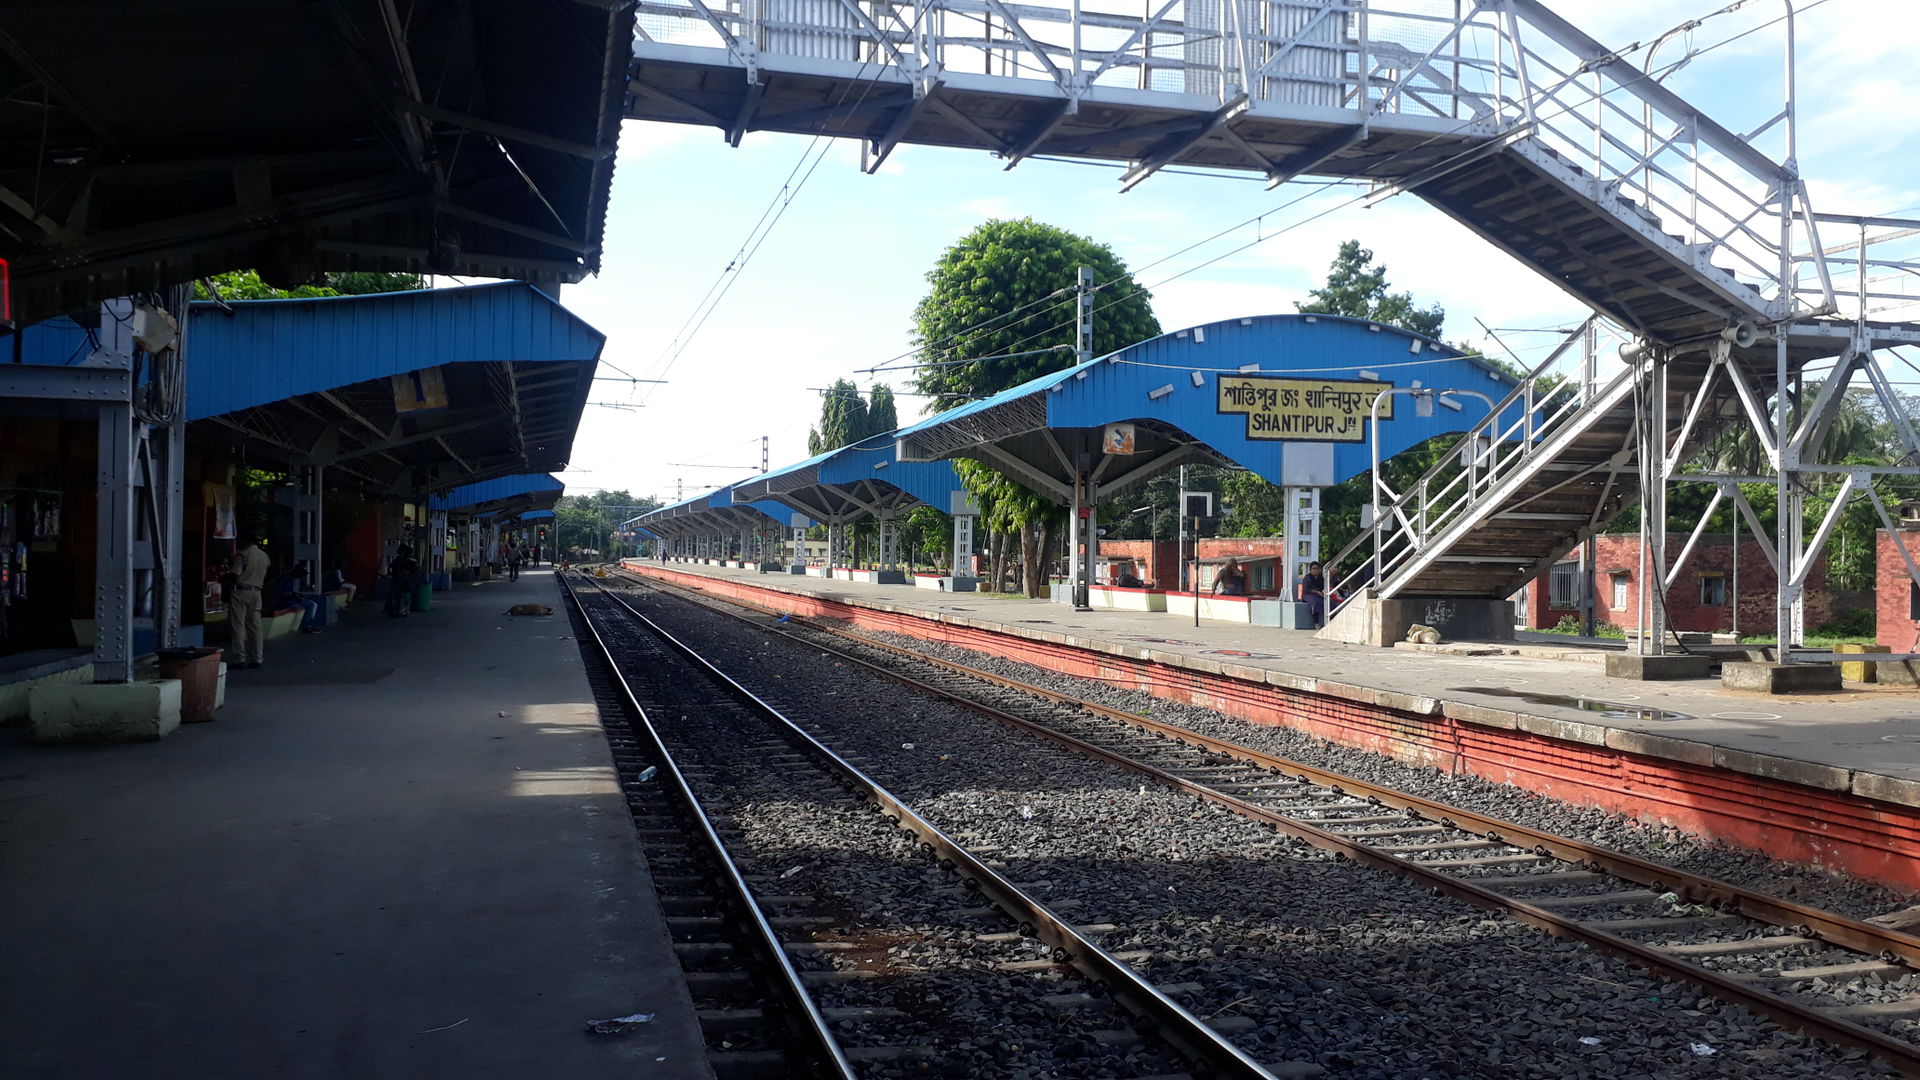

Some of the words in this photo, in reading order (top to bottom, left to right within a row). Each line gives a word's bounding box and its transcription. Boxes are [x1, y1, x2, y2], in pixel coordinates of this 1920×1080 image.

[1223, 382, 1279, 412] শান্তিপুর
[1280, 388, 1300, 409] জং
[1304, 385, 1363, 415] शान्तिपुर
[1252, 412, 1335, 434] SHANTIPUR
